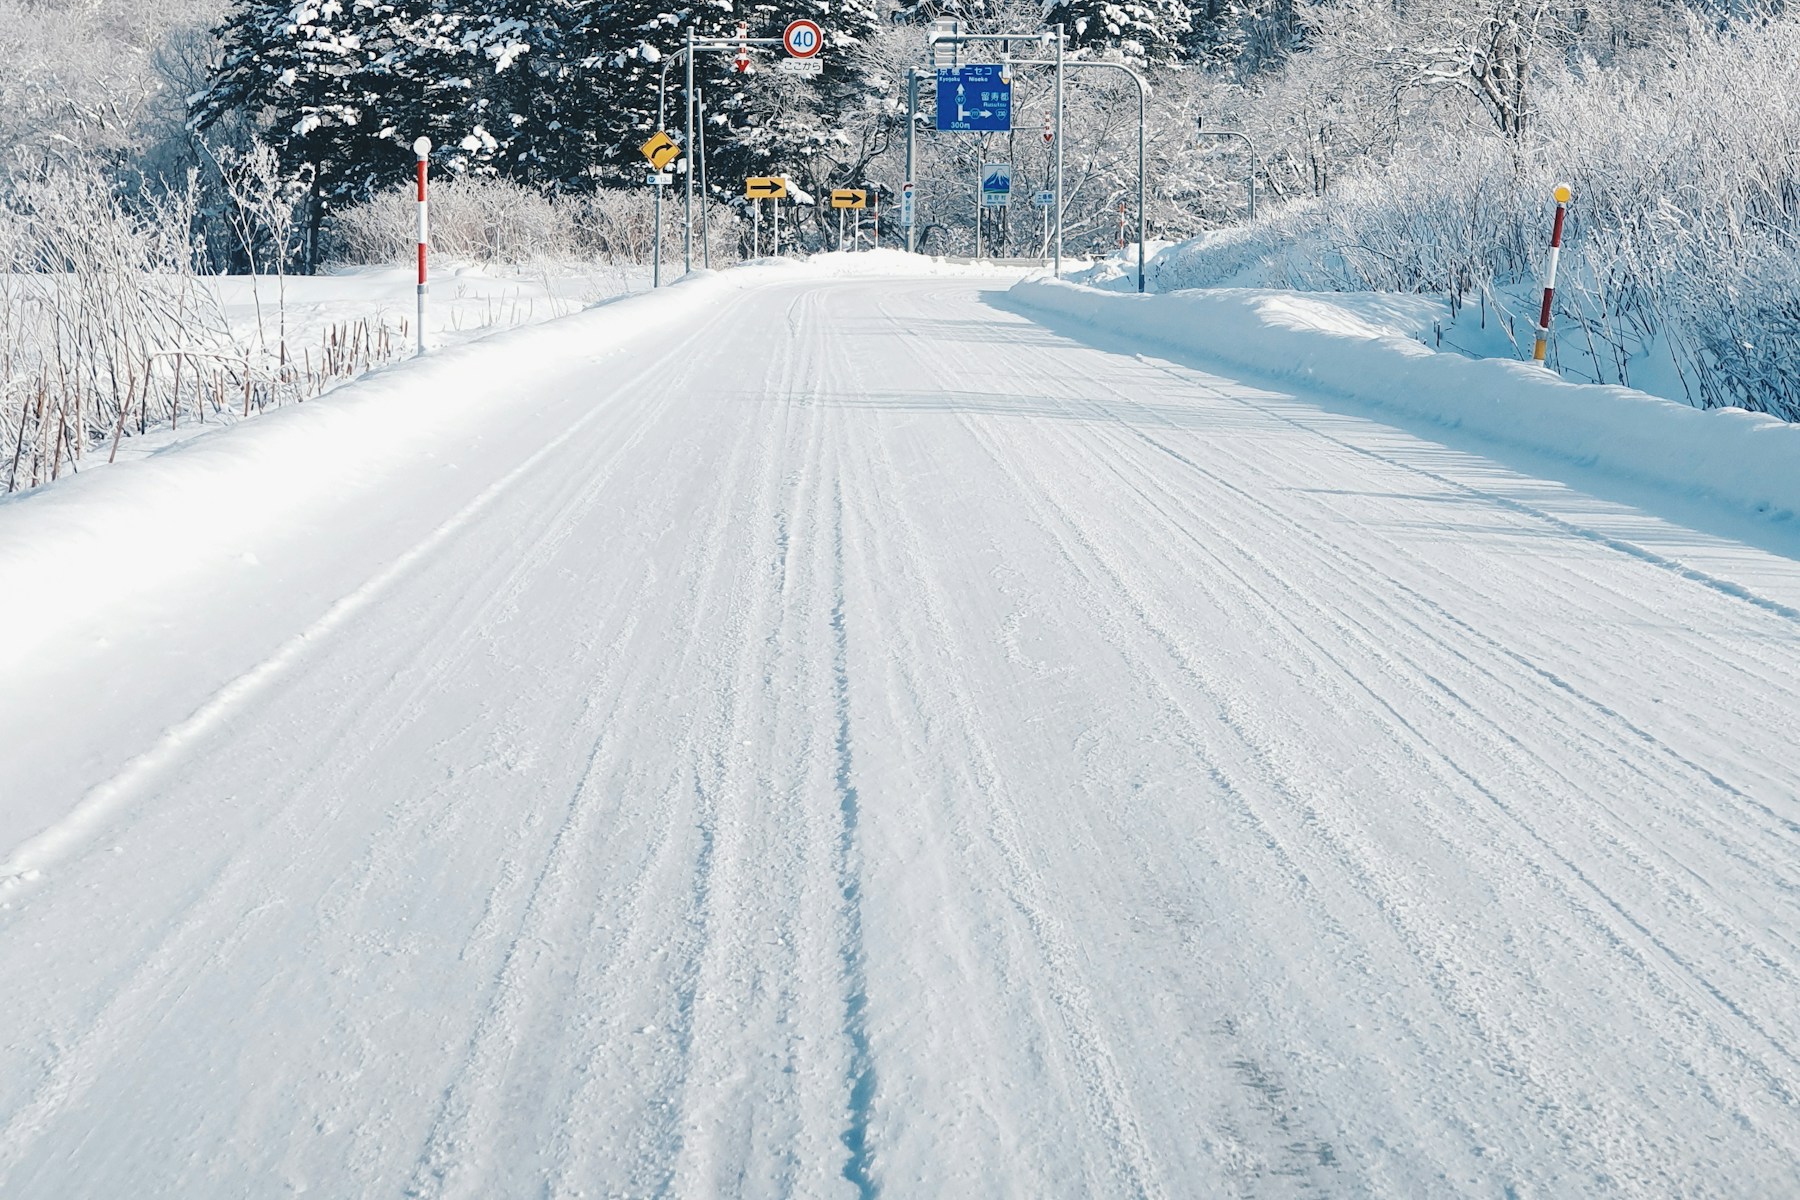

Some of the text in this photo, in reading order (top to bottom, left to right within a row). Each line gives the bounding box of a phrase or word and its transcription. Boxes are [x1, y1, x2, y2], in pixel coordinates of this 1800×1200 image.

[793, 31, 813, 47] 40
[785, 62, 821, 70] ここから
[965, 67, 992, 75] ニセコ
